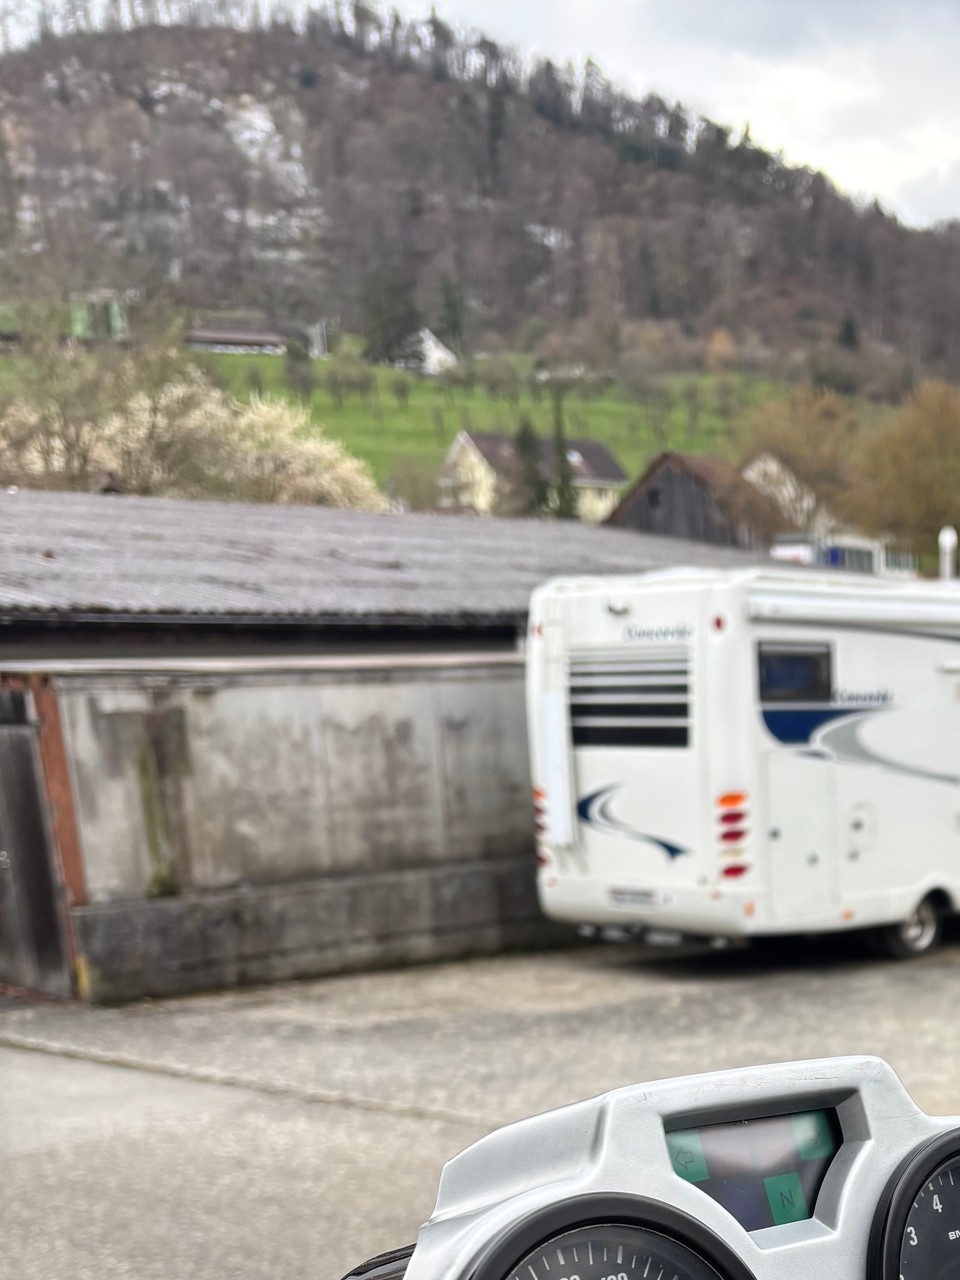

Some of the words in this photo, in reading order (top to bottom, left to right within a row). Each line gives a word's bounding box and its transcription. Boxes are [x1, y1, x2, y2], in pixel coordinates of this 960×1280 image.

[780, 1189, 795, 1210] N
[932, 1194, 943, 1213] 4
[906, 1226, 919, 1246] 3
